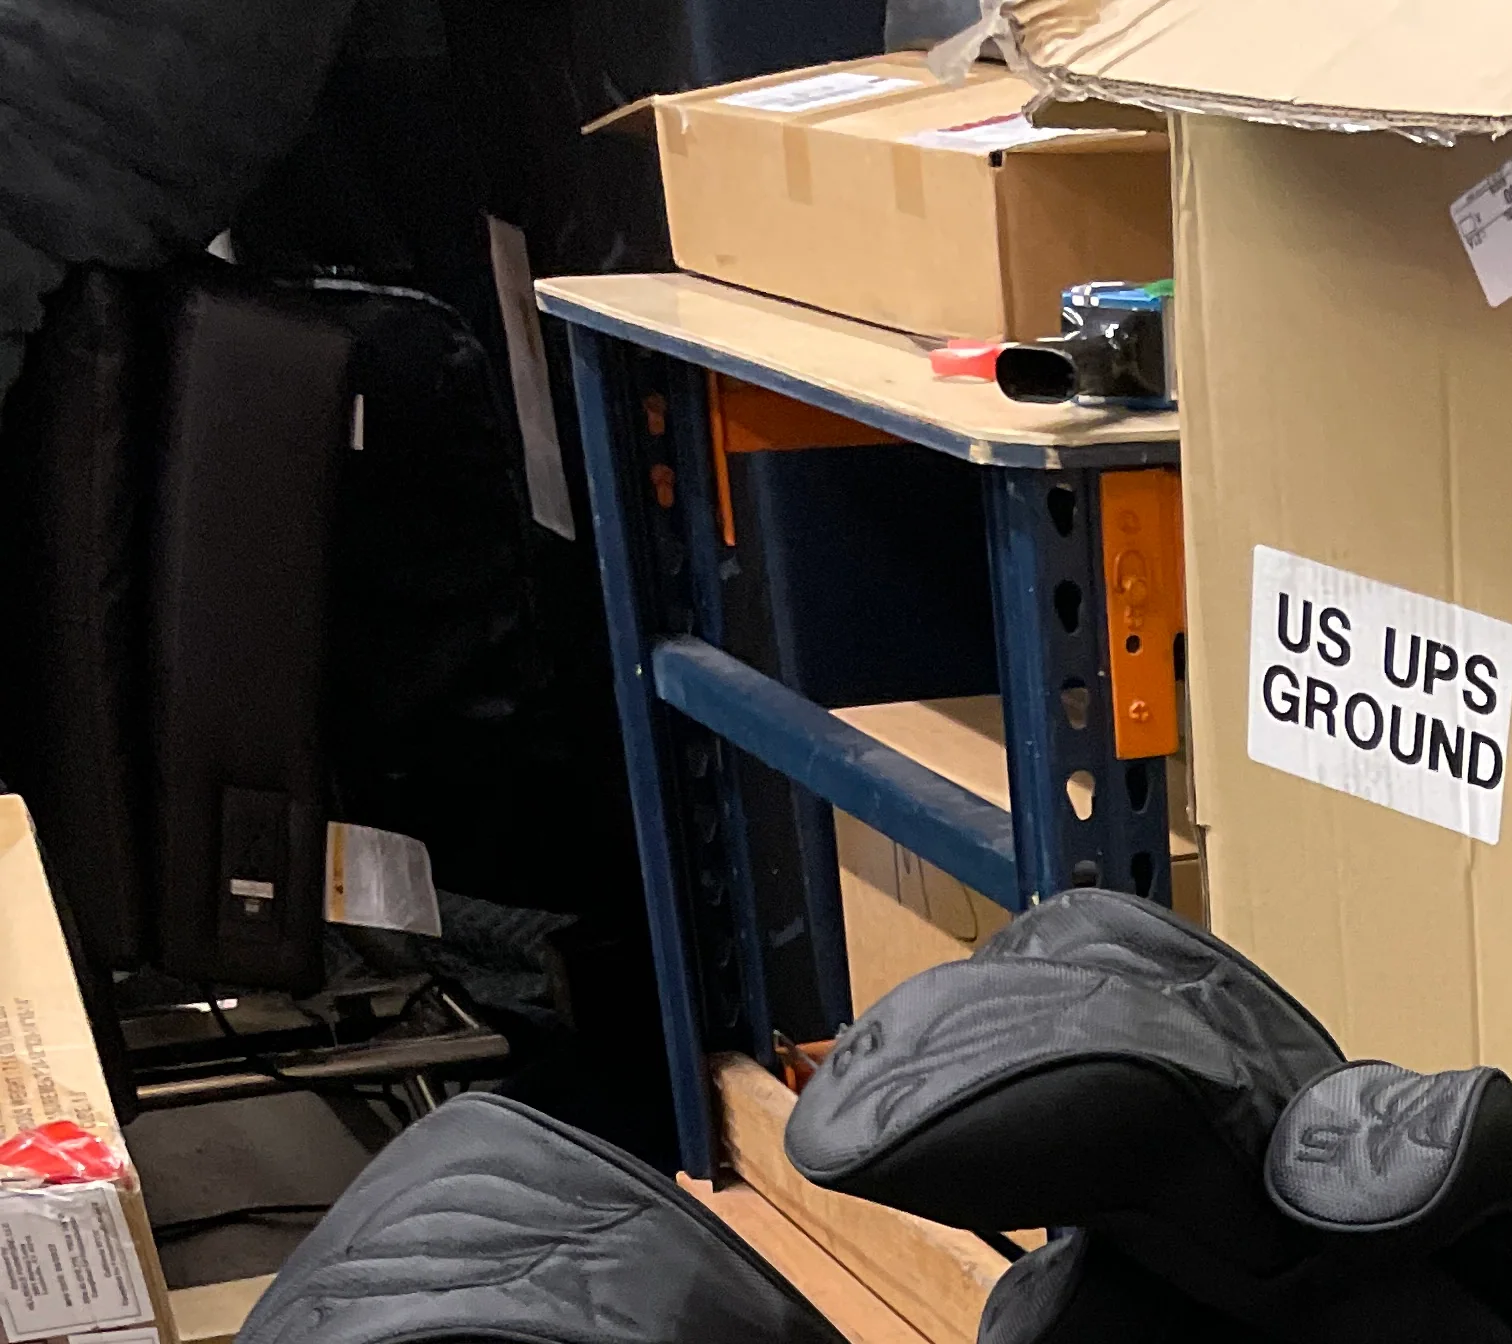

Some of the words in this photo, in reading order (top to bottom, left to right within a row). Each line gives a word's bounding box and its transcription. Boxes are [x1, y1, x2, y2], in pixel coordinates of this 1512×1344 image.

[1277, 591, 1351, 666] US
[1384, 625, 1498, 715] UPS
[1262, 664, 1504, 790] GROUND
